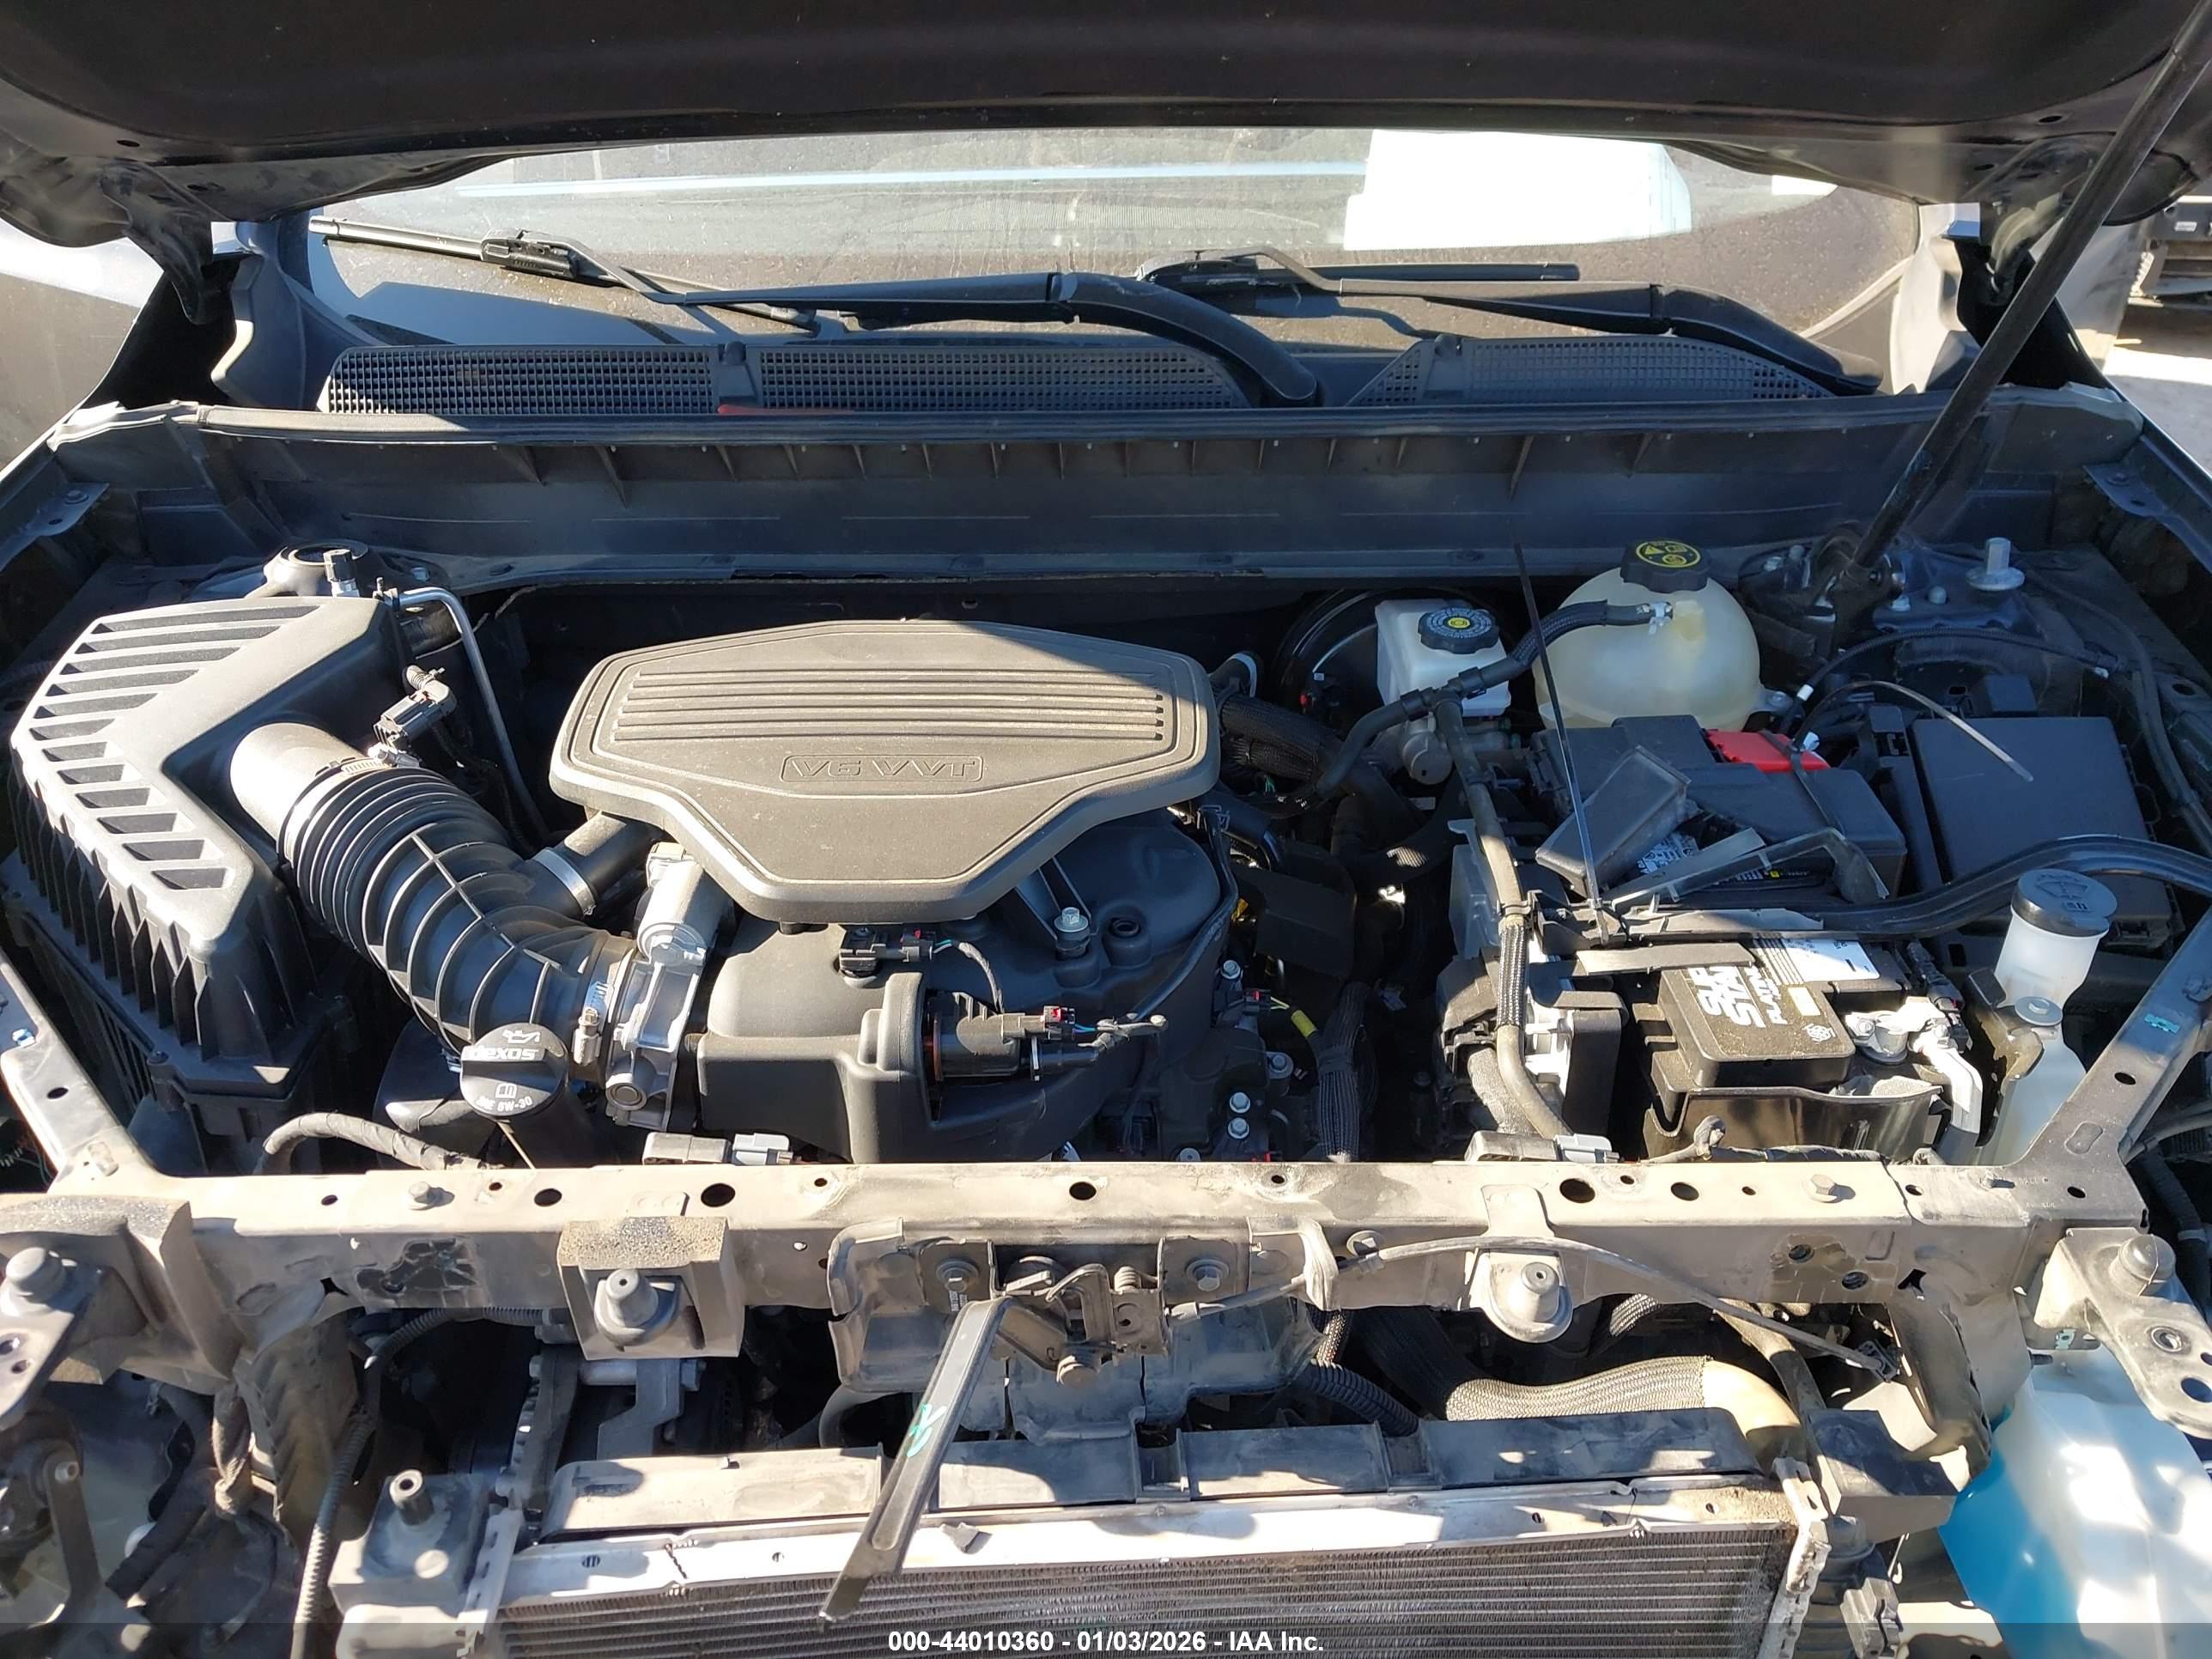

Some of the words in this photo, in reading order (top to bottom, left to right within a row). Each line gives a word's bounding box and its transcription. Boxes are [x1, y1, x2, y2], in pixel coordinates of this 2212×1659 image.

[792, 760, 861, 777] V6
[872, 760, 975, 777] VVT
[1687, 967, 1731, 1017] SUP
[1710, 966, 1766, 1029] STA
[471, 1045, 539, 1060] dexos
[498, 1096, 533, 1111] 5W-30
